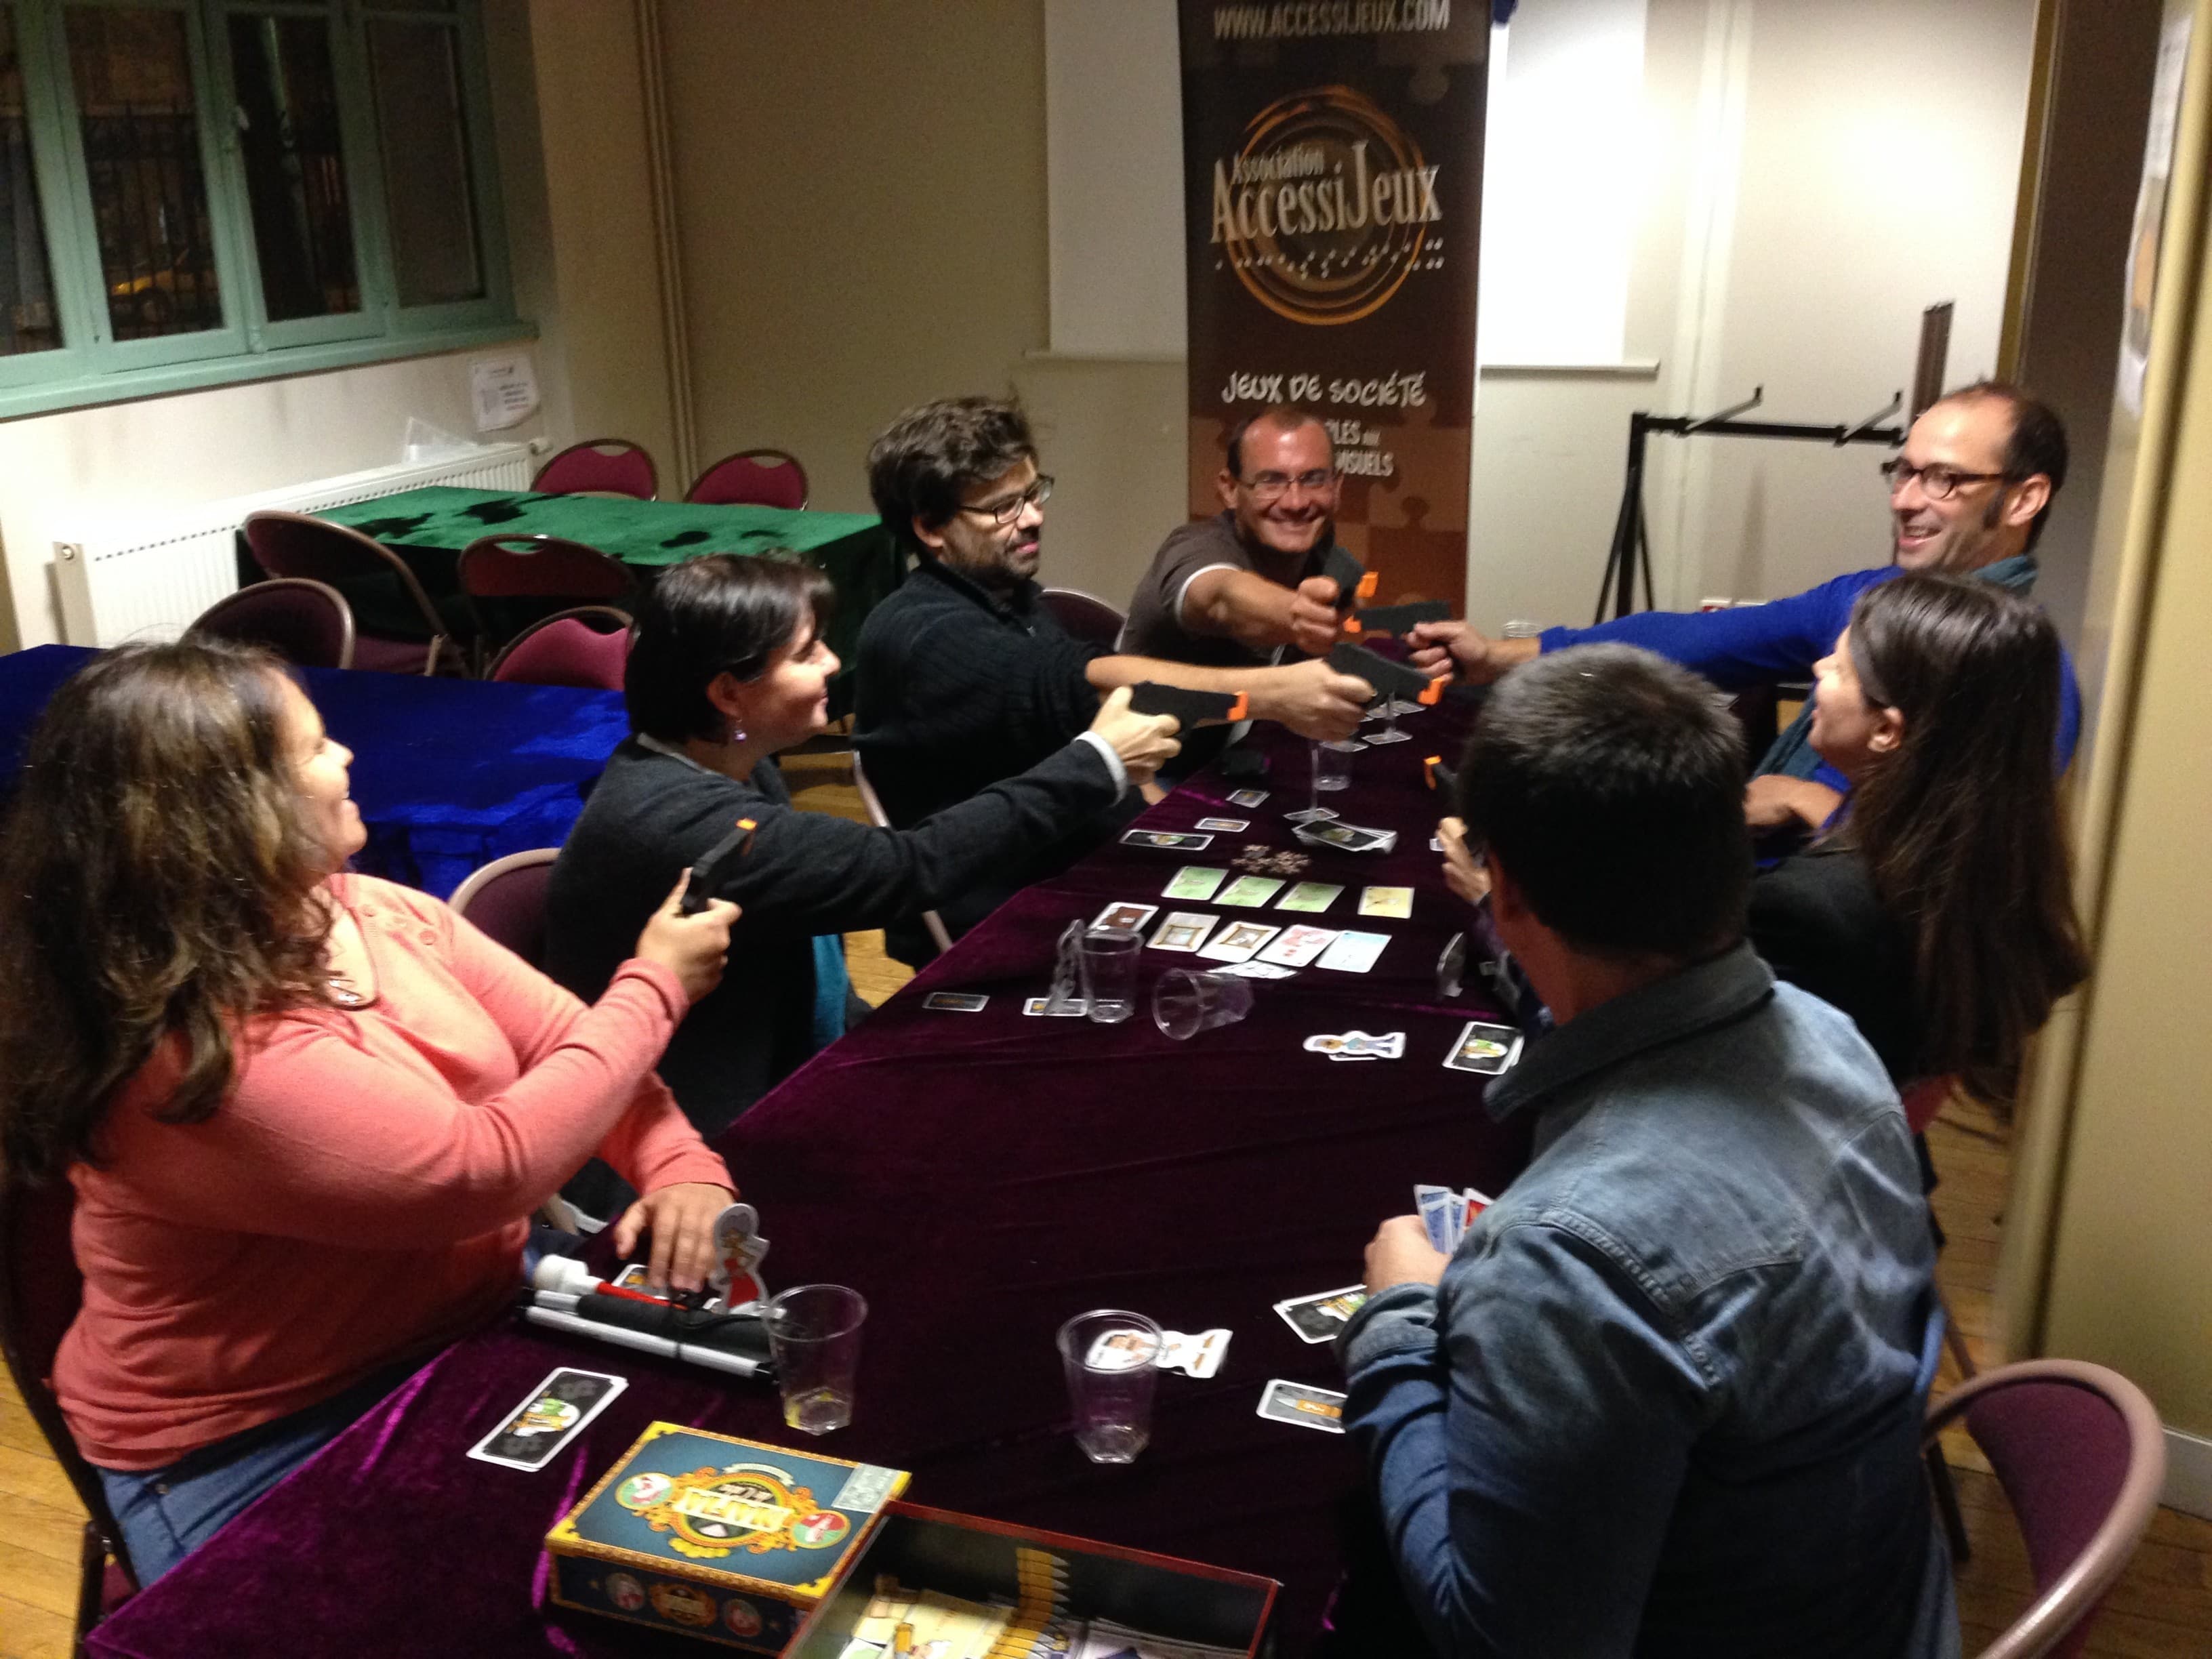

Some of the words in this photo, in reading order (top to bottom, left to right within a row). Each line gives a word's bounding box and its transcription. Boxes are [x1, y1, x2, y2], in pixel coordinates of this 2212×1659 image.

[1210, 140, 1443, 243] AccessiJeux
[1221, 371, 1284, 403] JEUX
[1289, 373, 1323, 402] DE
[1328, 370, 1426, 407] SOCIÉTÉ
